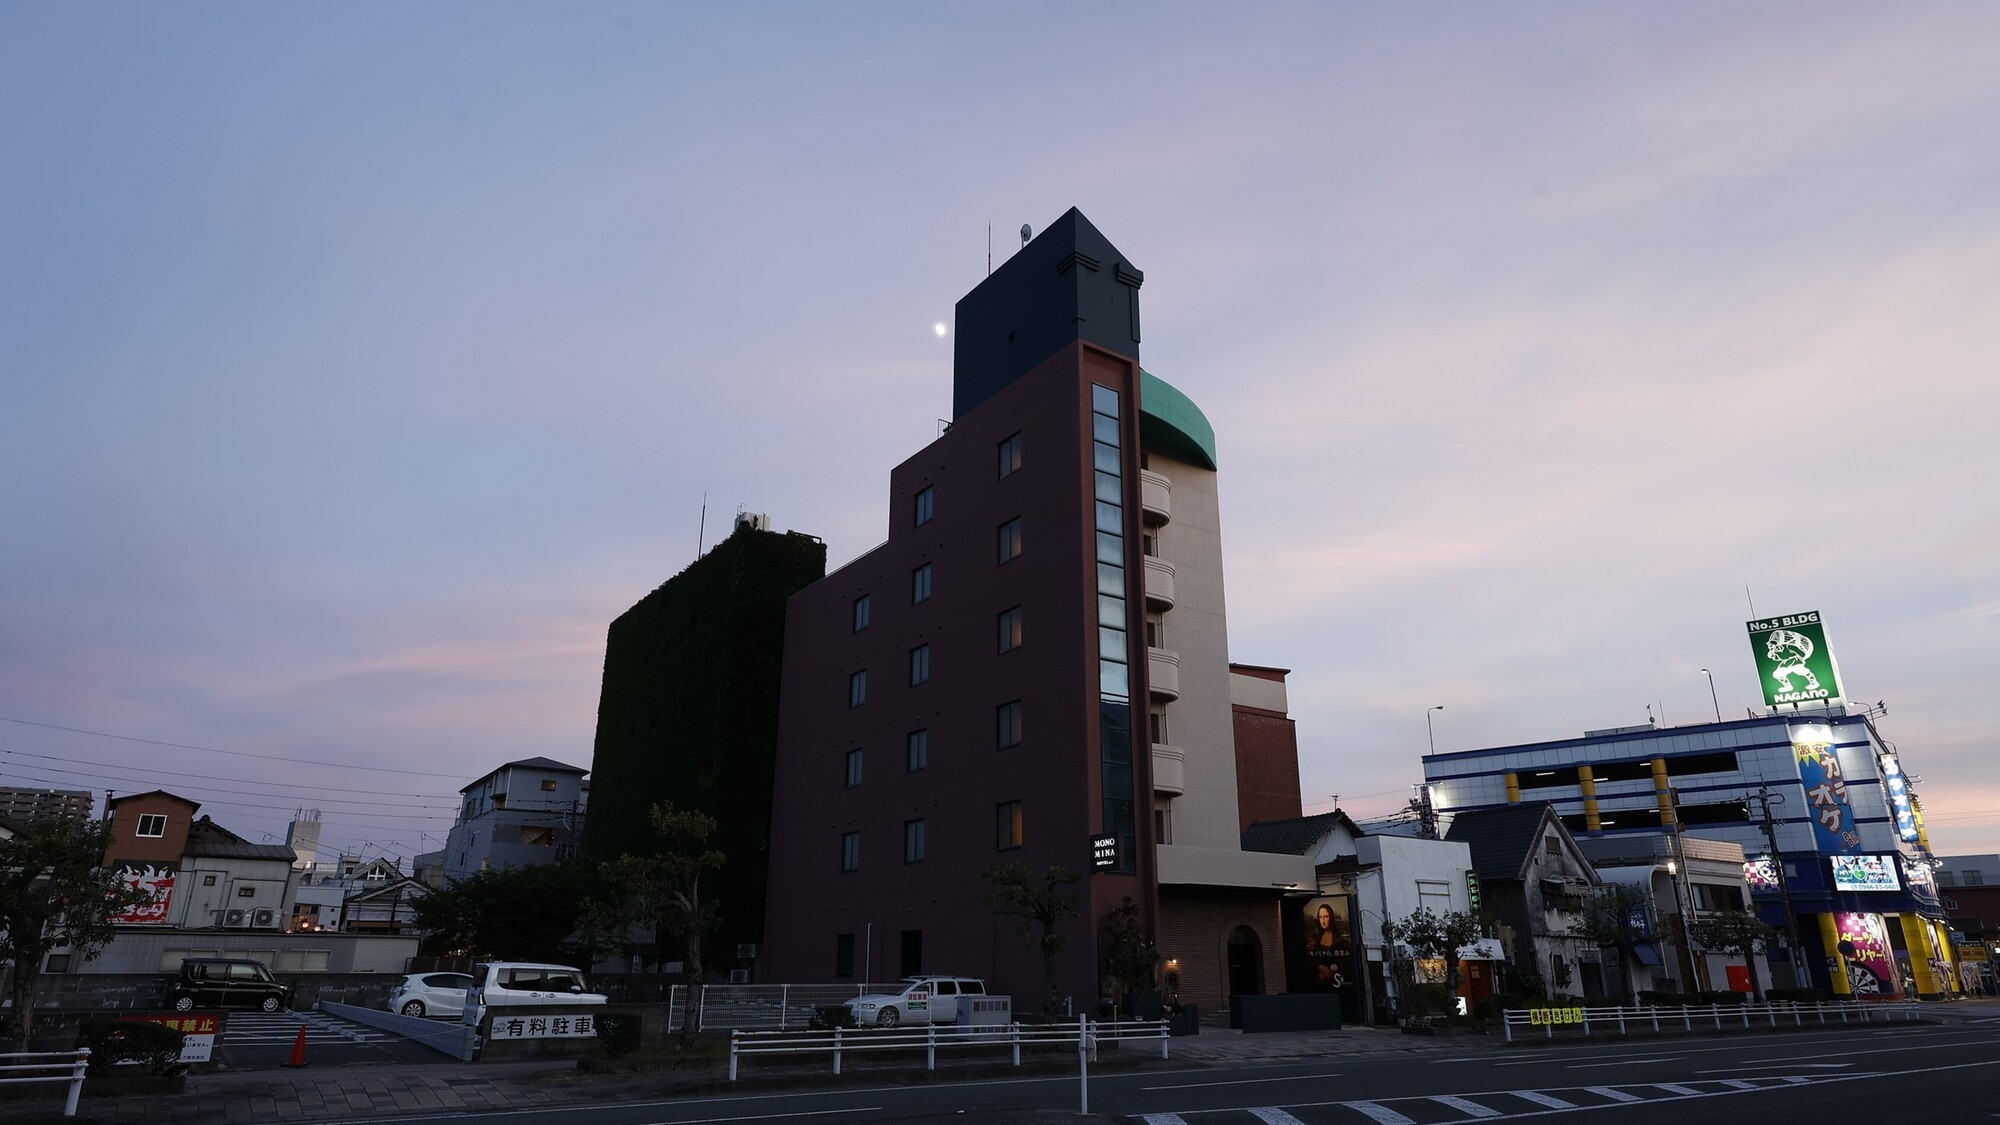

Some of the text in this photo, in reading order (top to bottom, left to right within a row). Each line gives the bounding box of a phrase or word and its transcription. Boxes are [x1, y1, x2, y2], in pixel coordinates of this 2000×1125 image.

[1750, 612, 1818, 631] No.5 BLDG
[1773, 688, 1829, 703] NAGANO
[1798, 743, 1824, 756] 激安
[1808, 755, 1848, 832] カラオケ
[1094, 838, 1116, 848] MONO
[1094, 848, 1116, 858] MINA
[1841, 932, 1874, 945] ダーツ
[1531, 1010, 1581, 1023] 横断きけん
[507, 1017, 592, 1037] 有料駐車
